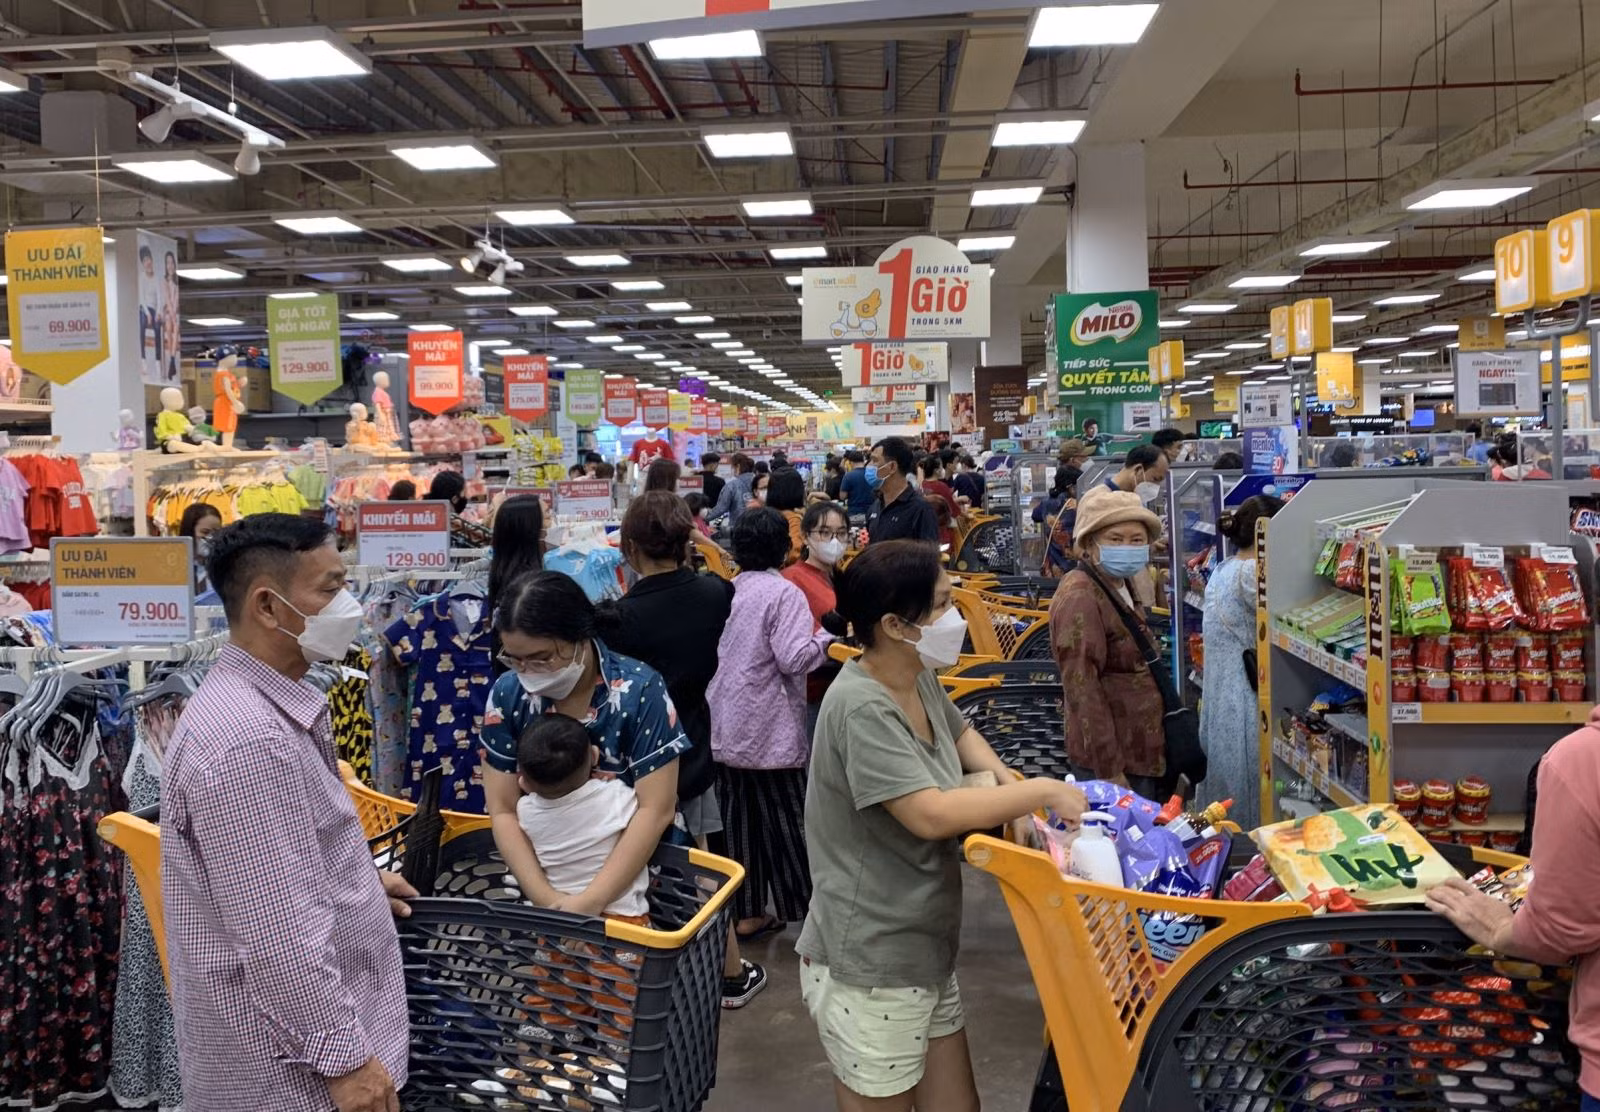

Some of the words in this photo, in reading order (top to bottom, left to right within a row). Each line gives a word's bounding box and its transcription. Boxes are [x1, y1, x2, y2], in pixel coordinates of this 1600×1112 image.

[1557, 221, 1575, 265] 9
[916, 265, 939, 274] GIAO
[1499, 240, 1523, 281] 10
[879, 248, 913, 339] 1
[911, 276, 970, 313] Giờ
[49, 319, 91, 333] 69.900
[1081, 312, 1135, 335] MILO
[281, 361, 329, 374] 129.900
[872, 350, 905, 370] Giờ
[1063, 357, 1087, 368] TIẾP
[1088, 357, 1110, 368] SỨC
[1061, 368, 1116, 388] QUYẾT
[1090, 386, 1127, 395] TRONG
[1129, 384, 1153, 393] CON
[362, 509, 410, 526] KHUYẾN
[412, 510, 436, 525] MÃI
[386, 552, 446, 567] 129.900
[62, 565, 105, 579] THÀNH
[107, 566, 136, 579] VIÊN
[117, 602, 178, 621] 79.900
